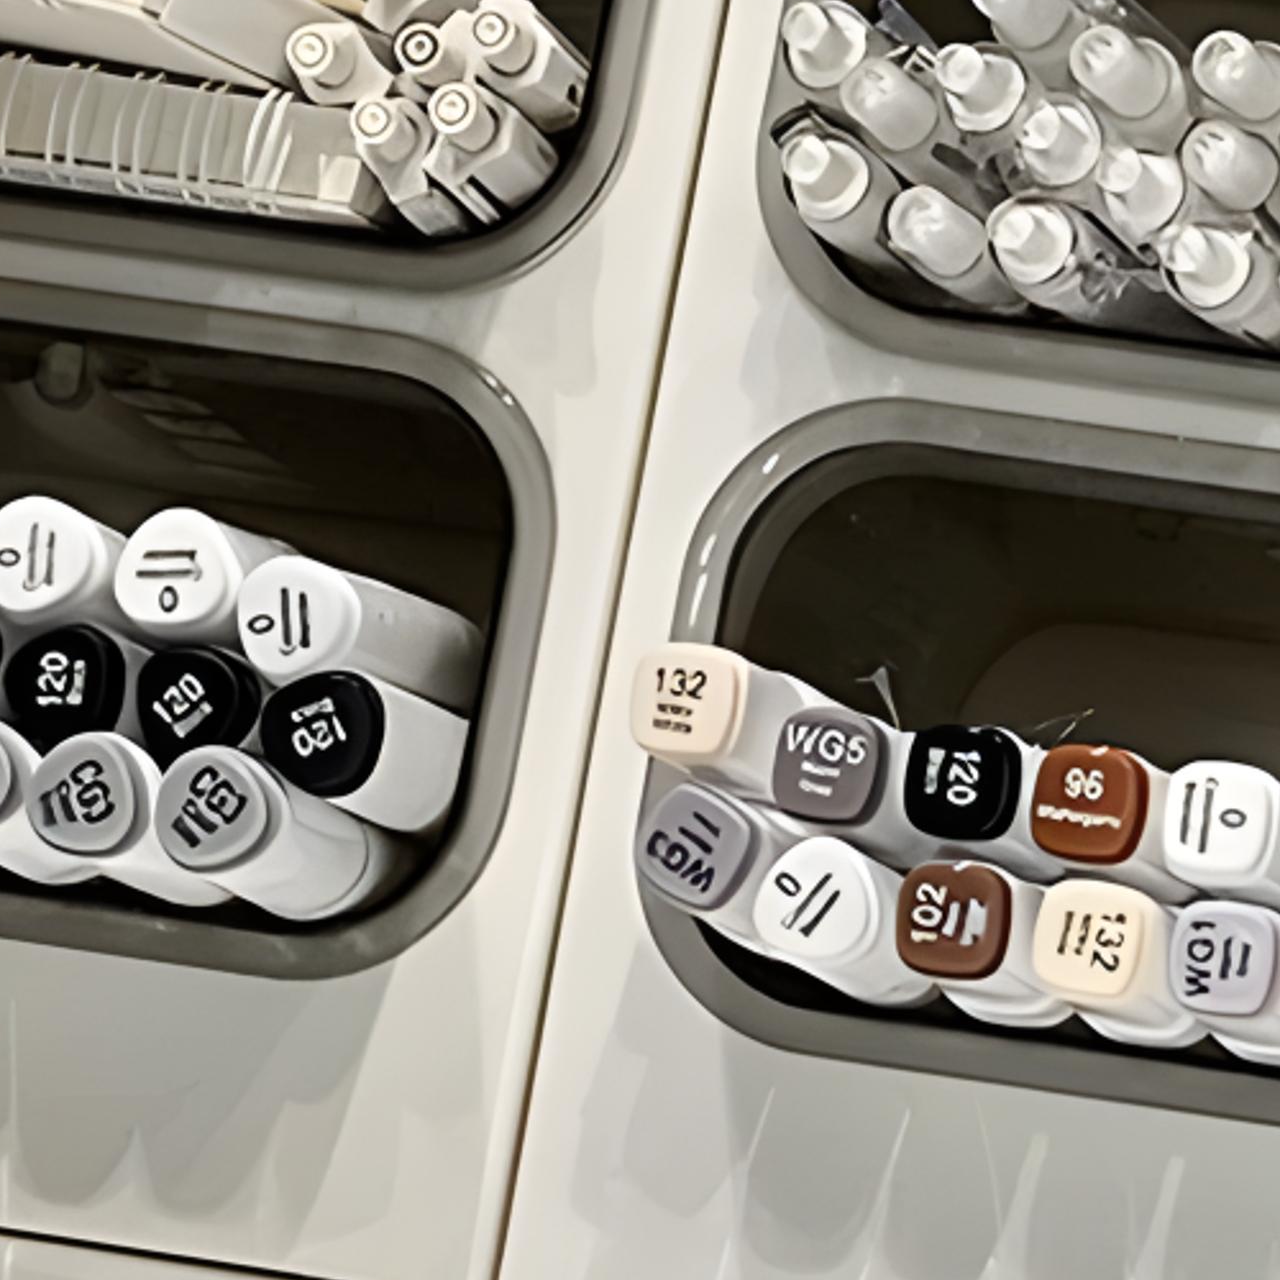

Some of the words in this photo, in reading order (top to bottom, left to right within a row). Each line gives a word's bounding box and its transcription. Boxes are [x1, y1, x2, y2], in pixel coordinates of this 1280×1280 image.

[36, 650, 70, 707] 120
[152, 673, 206, 724] 120
[654, 667, 708, 701] 132
[945, 749, 982, 807] 120
[910, 883, 949, 943] 102
[1090, 912, 1126, 973] 132
